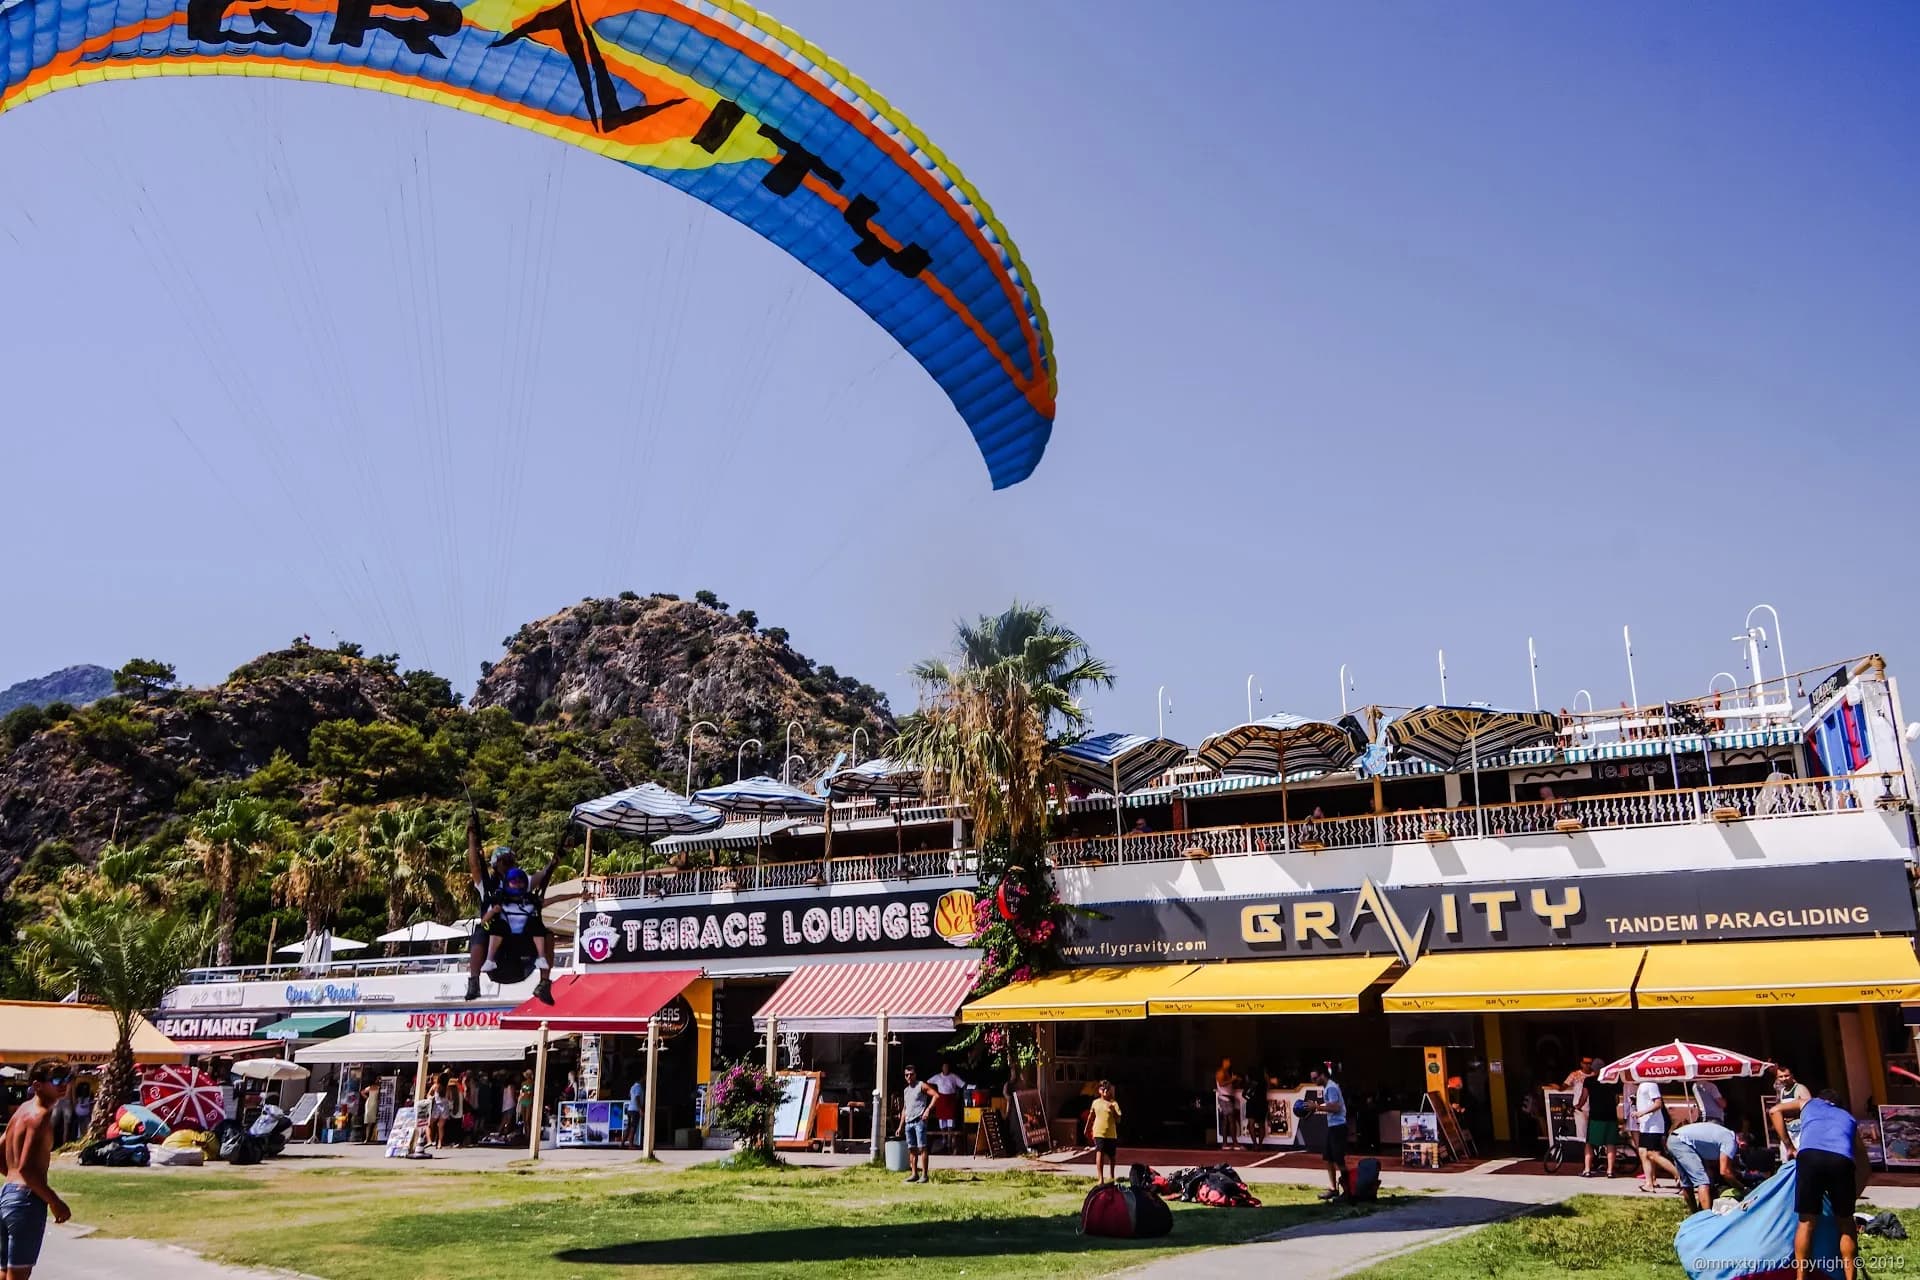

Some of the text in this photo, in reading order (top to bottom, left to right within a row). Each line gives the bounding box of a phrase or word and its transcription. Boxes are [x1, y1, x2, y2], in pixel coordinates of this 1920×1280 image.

[622, 902, 931, 952] TERRACE LOUNGE
[1240, 876, 1583, 966] GRAVITY
[1605, 906, 1870, 934] TANDEM PARAGLIDING
[1062, 939, 1207, 957] www.flygravity.com
[1755, 991, 1795, 1000] GRAVITY
[1860, 987, 1903, 997] GRAVITY
[156, 1018, 200, 1037] BEACH
[201, 1017, 257, 1037] MARKET
[406, 1011, 501, 1029] JUST LOOK
[67, 1054, 87, 1062] TAXI
[1645, 1066, 1677, 1075] ALGIDA
[1704, 1065, 1734, 1074] ALGIDA
